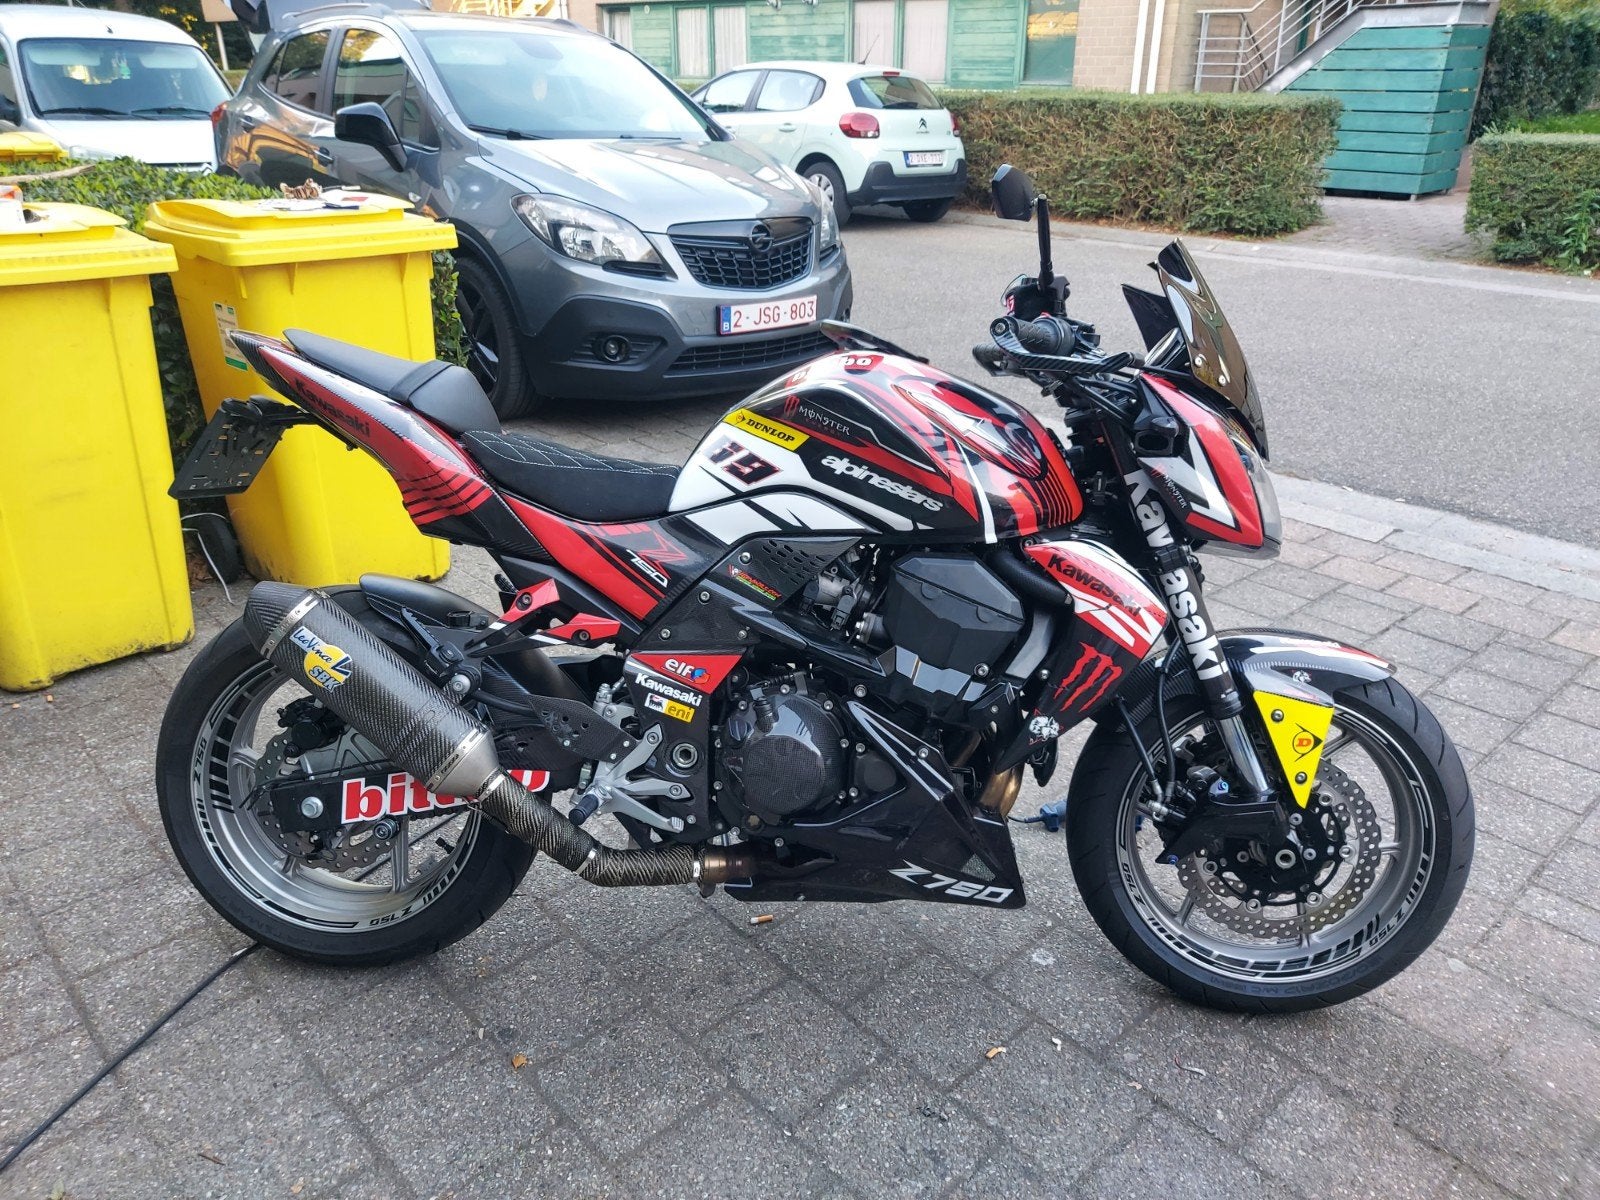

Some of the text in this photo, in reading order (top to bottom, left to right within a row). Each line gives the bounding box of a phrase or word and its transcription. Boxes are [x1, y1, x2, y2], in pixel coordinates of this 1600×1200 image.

[746, 418, 796, 443] DUNLOP
[821, 455, 944, 512] alpinestars
[1048, 553, 1142, 617] Kawasaki
[309, 665, 343, 693] SBK
[665, 658, 695, 677] elf
[635, 672, 703, 707] Kawasaki
[667, 705, 692, 721] eni
